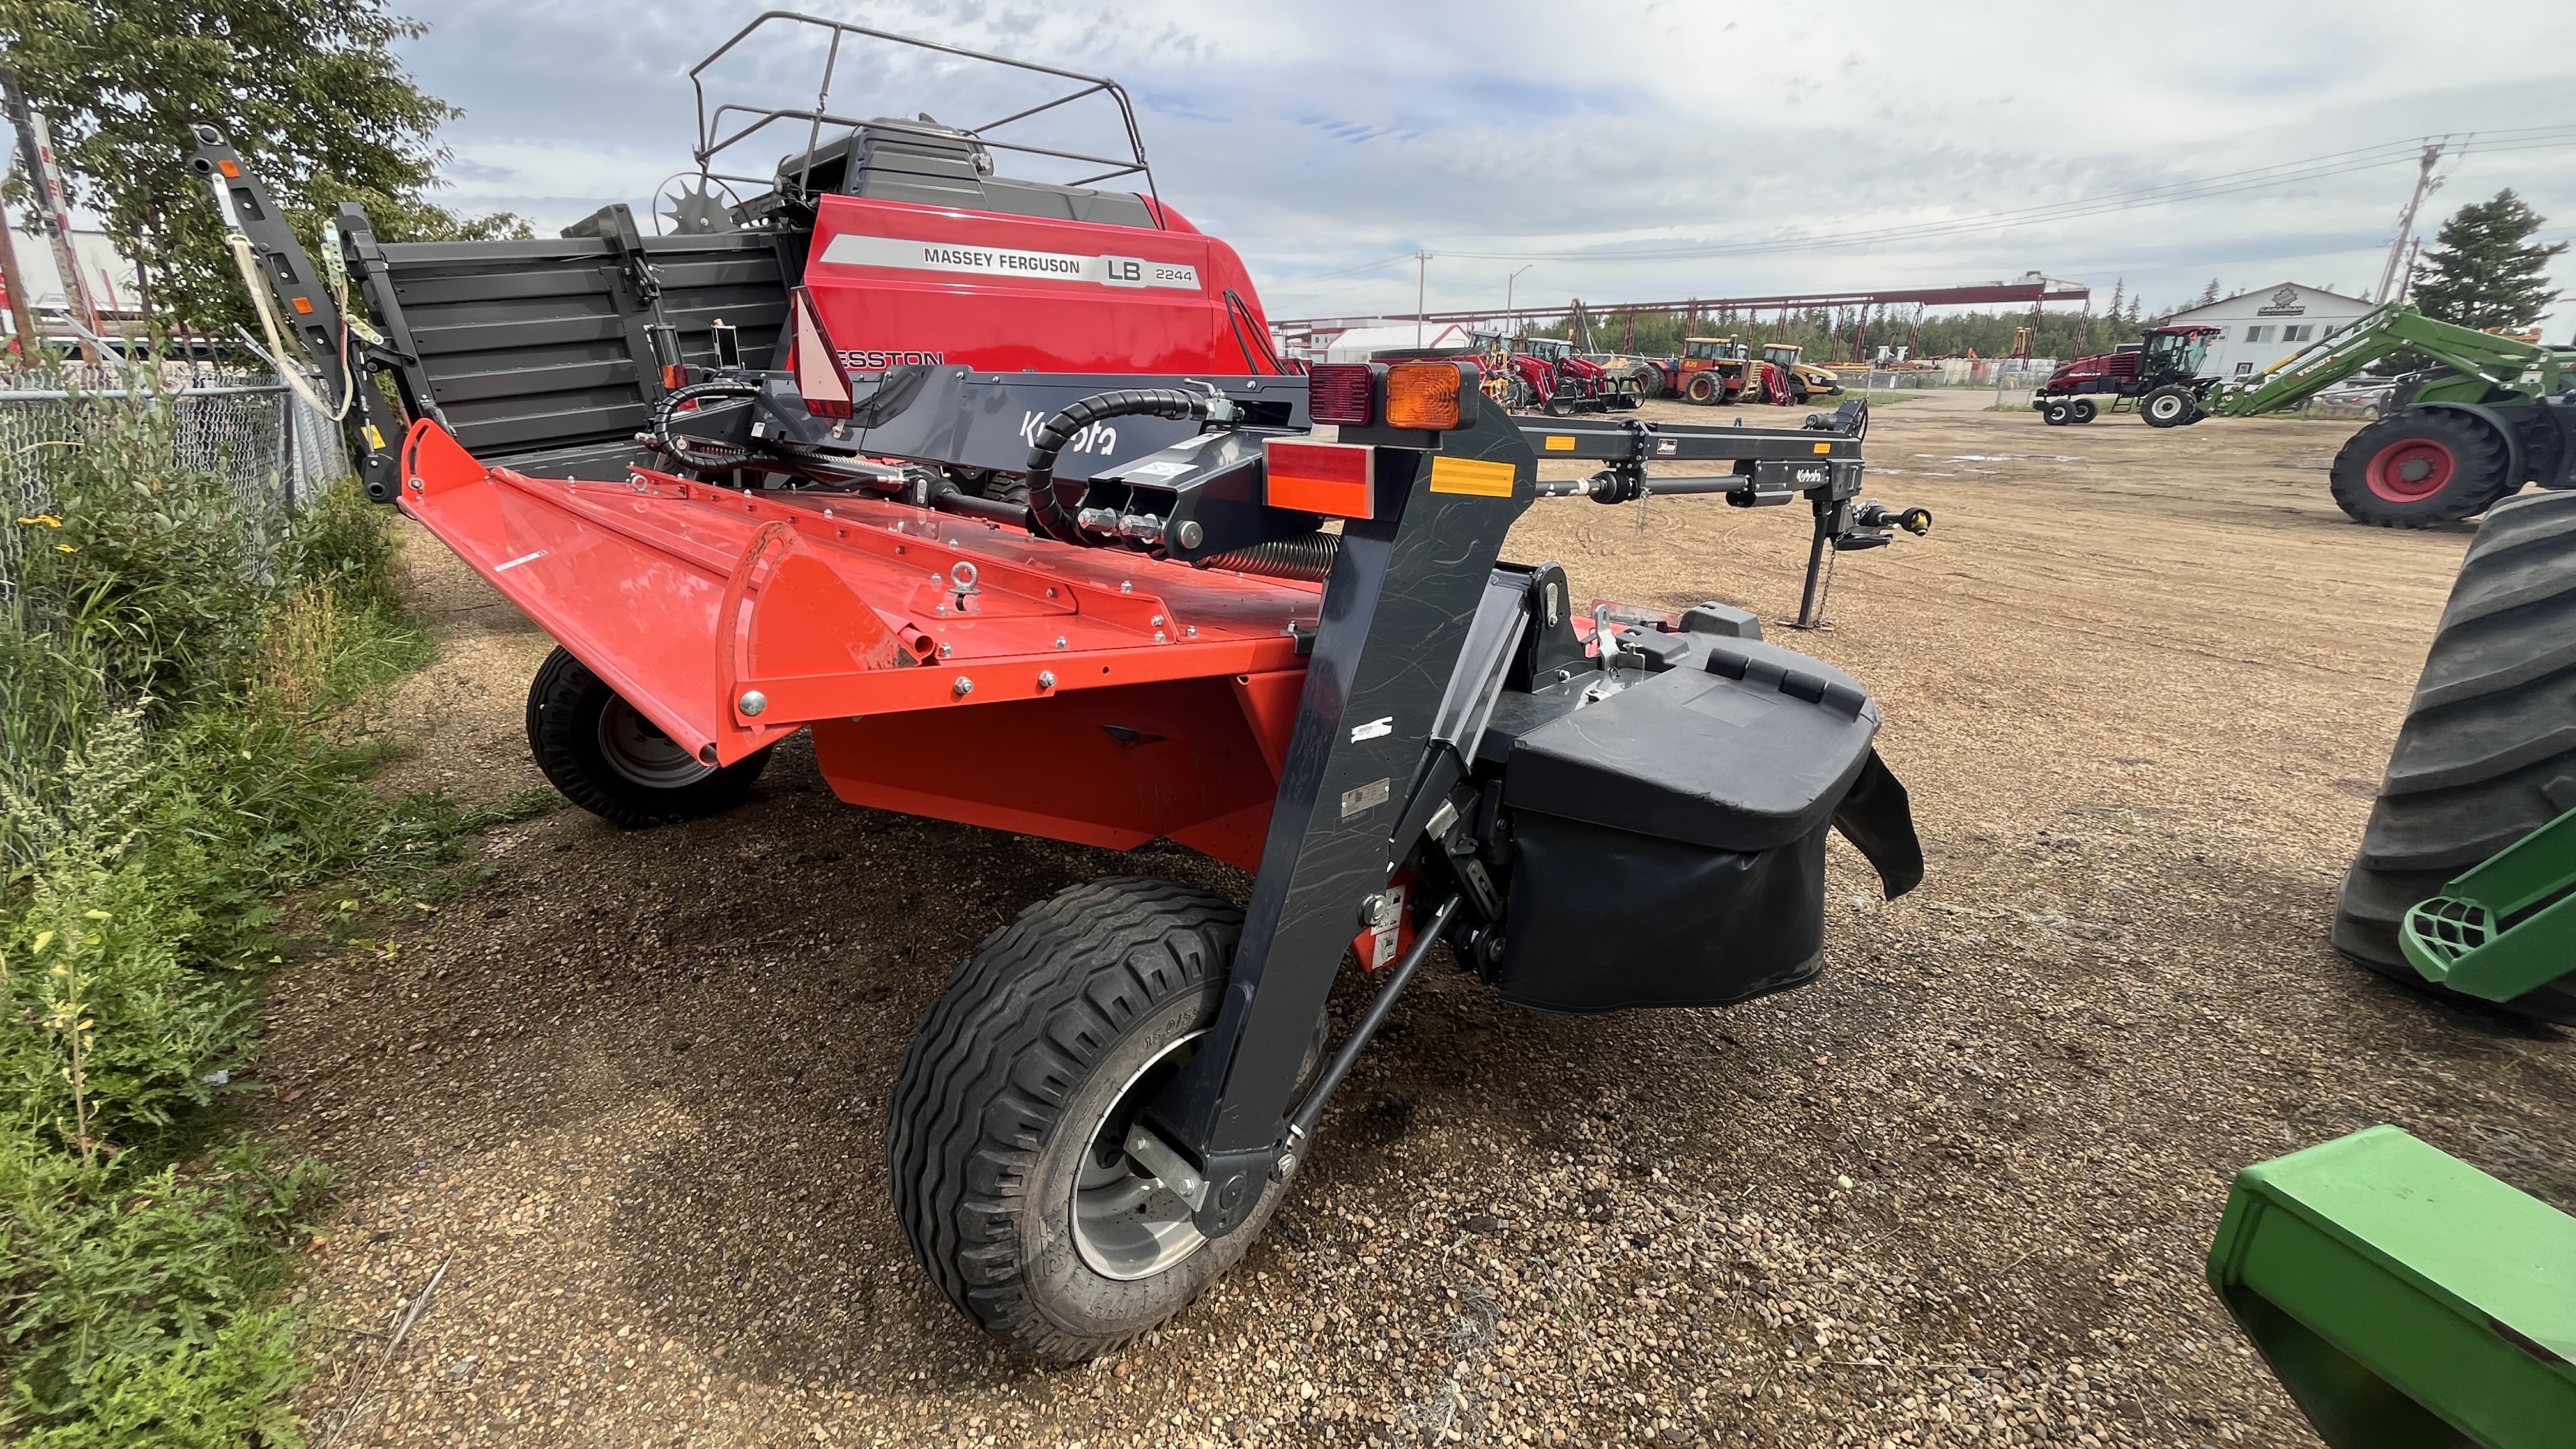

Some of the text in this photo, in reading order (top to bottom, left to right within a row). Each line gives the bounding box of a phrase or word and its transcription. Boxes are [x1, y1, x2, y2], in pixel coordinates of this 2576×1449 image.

[924, 247, 1080, 274] MASSEY FERGUSON
[1107, 259, 1141, 281] LB
[1155, 268, 1193, 282] 2244
[1019, 410, 1117, 456] Kota
[1796, 468, 1821, 483] Kubota
